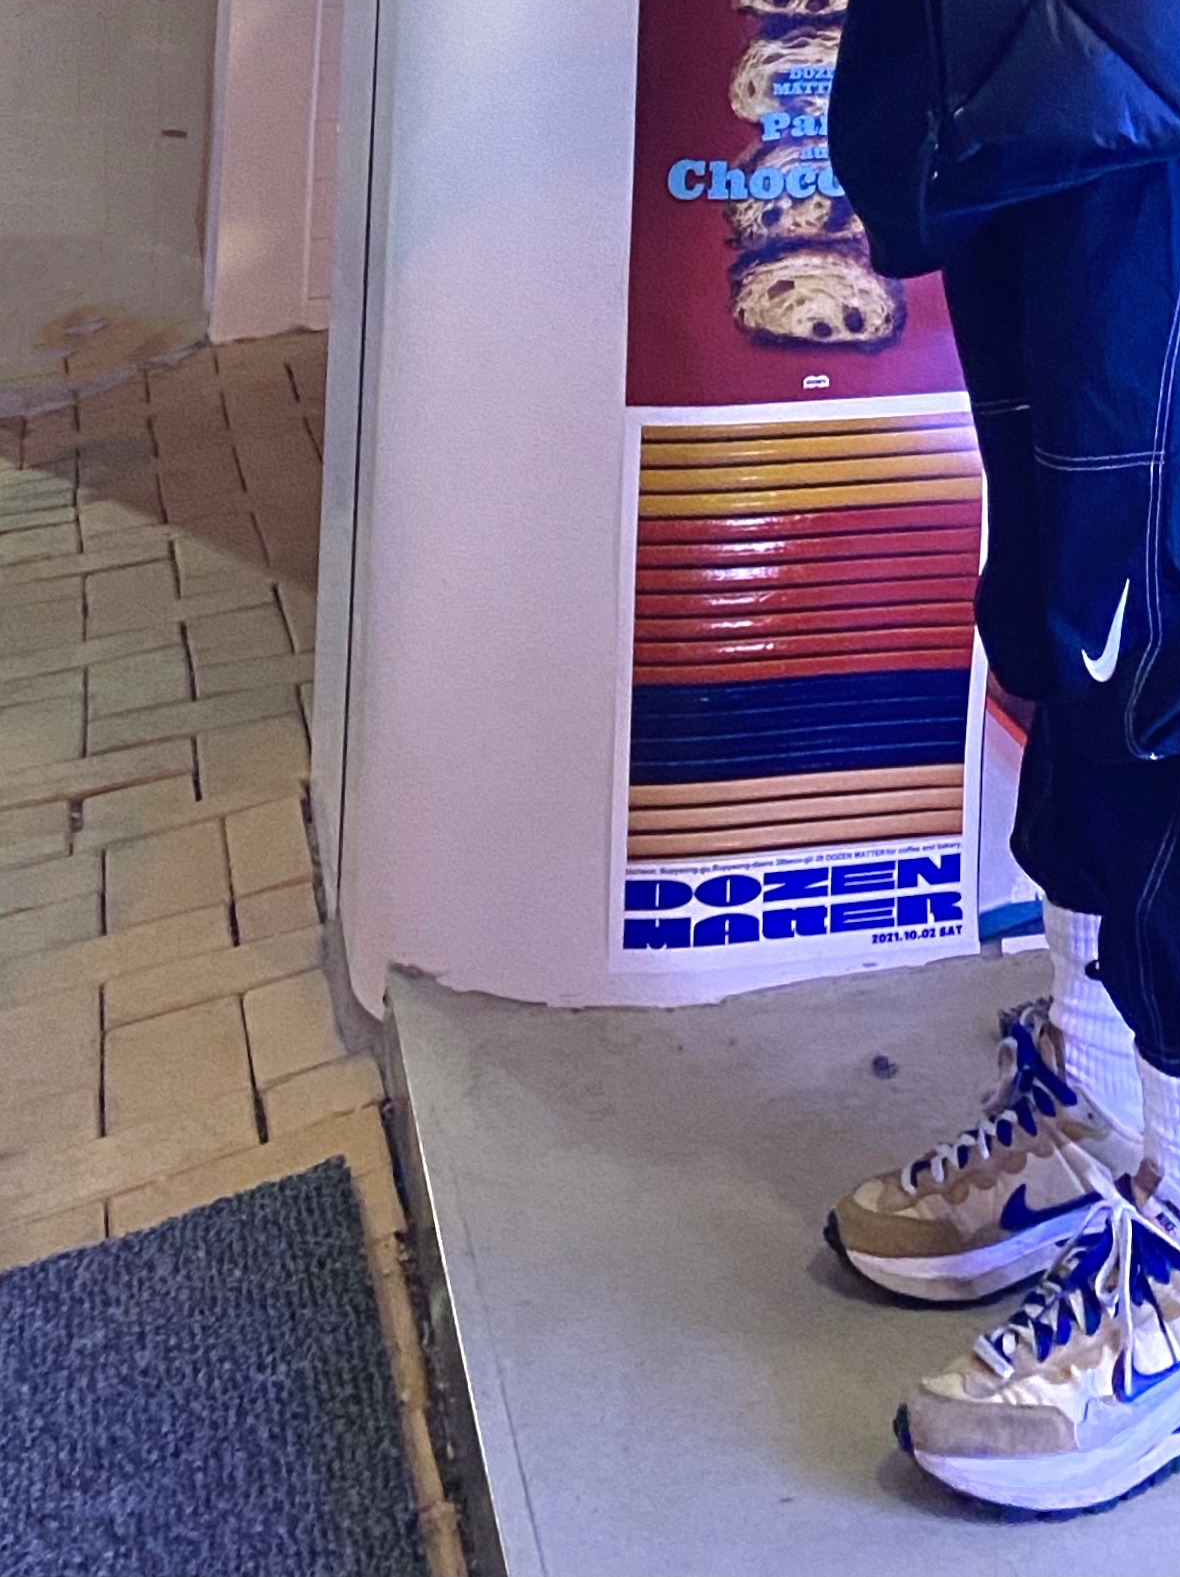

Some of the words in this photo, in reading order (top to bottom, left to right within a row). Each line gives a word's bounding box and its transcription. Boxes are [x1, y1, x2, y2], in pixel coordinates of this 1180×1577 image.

[788, 67, 835, 80] DOZ
[773, 81, 832, 96] MATT
[826, 853, 853, 862] DOZEN
[854, 849, 885, 858] MATTER
[898, 845, 920, 854] coffee
[625, 853, 962, 912] DOZEN
[872, 927, 936, 944] 2021.10.02
[939, 925, 963, 938] SAT
